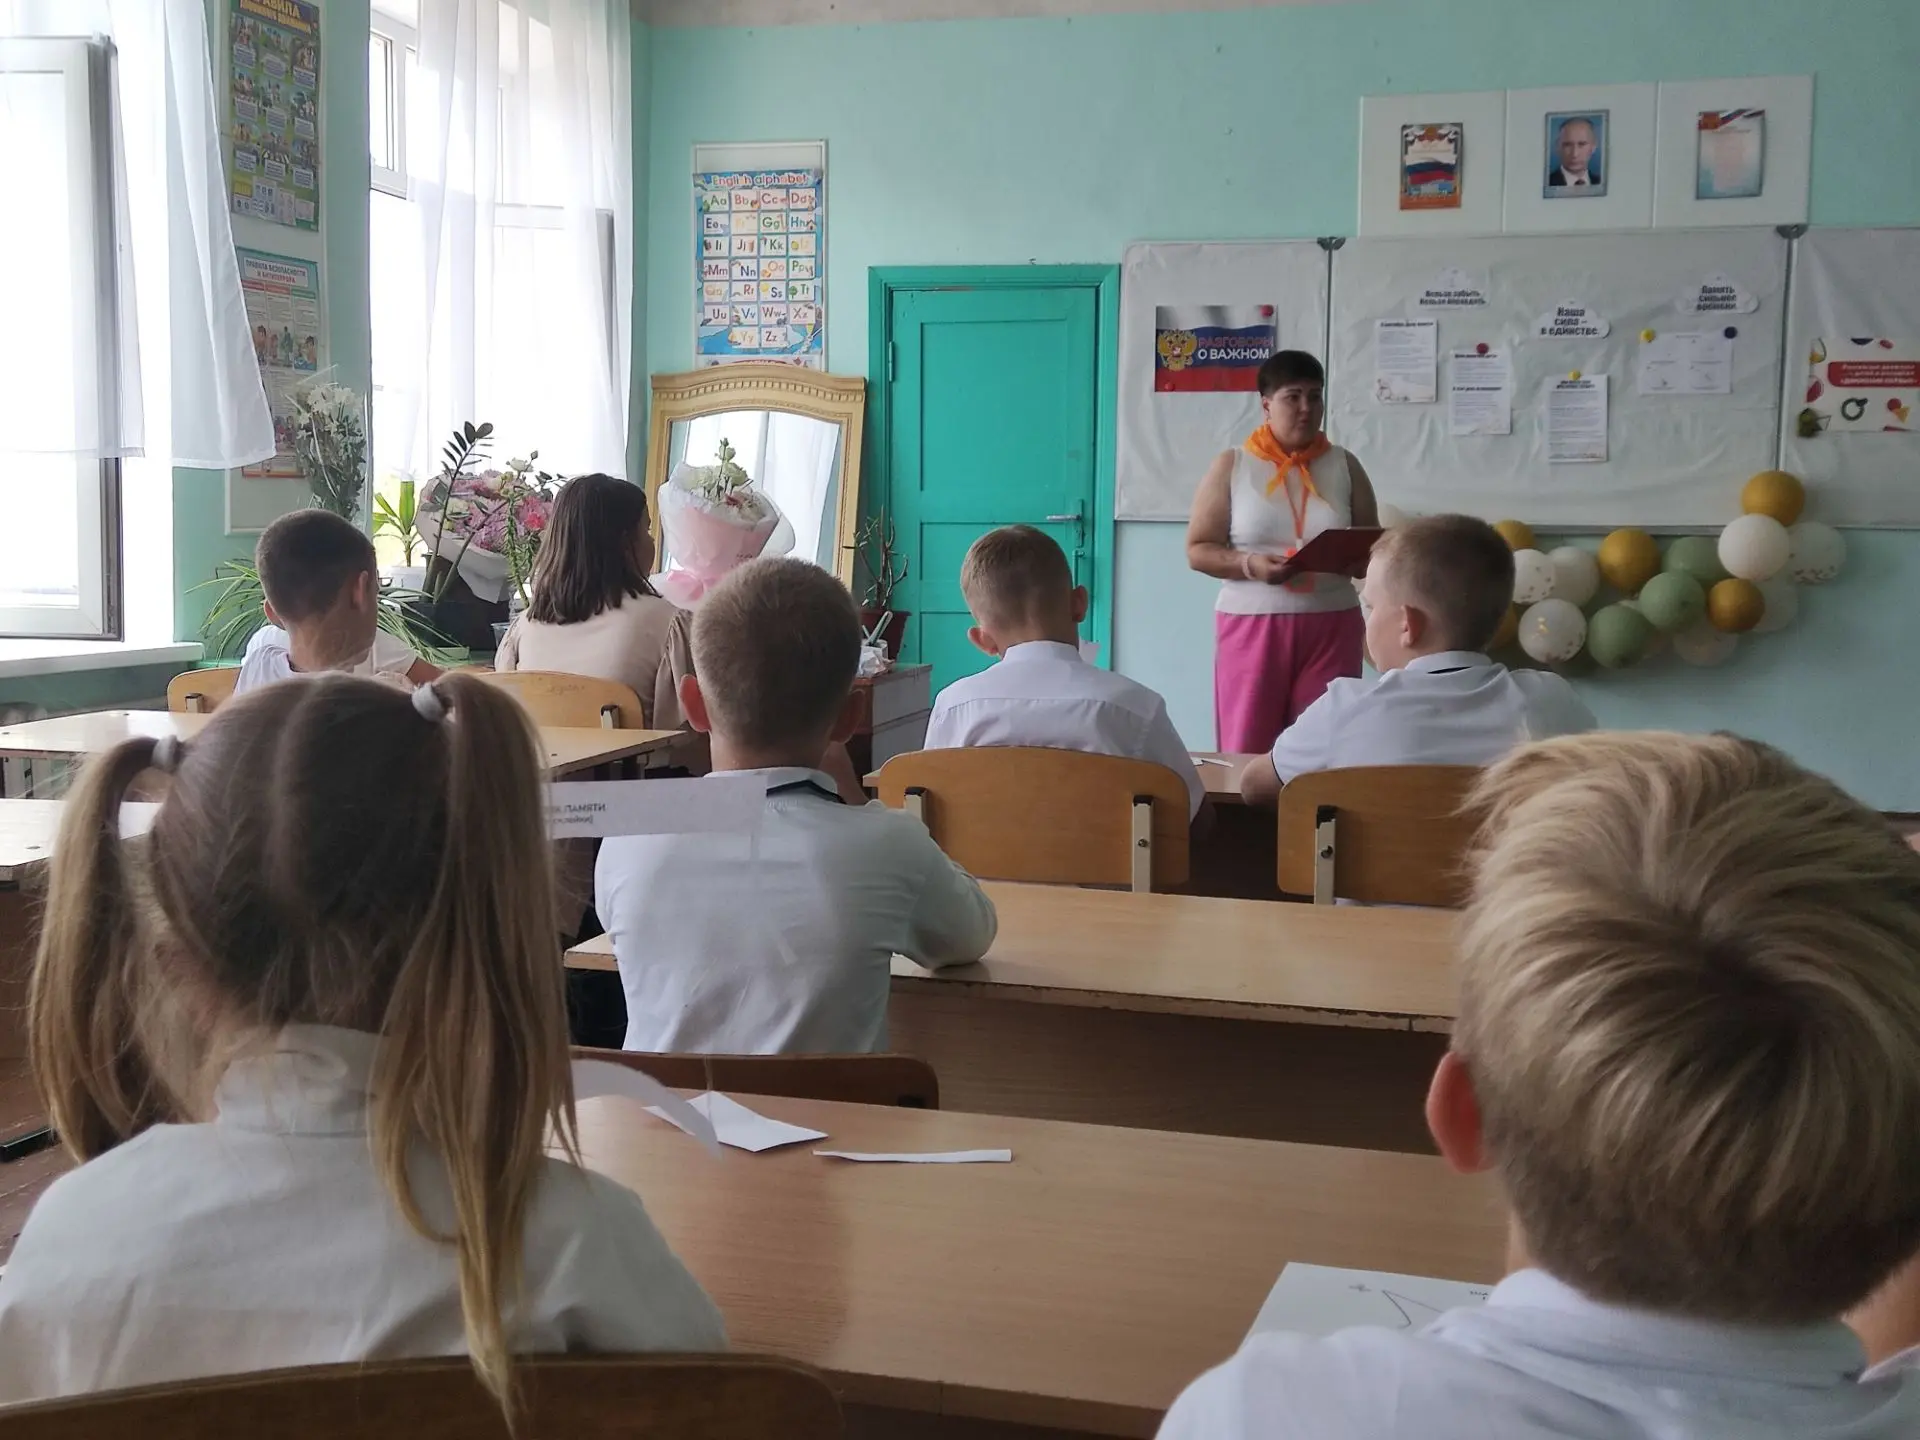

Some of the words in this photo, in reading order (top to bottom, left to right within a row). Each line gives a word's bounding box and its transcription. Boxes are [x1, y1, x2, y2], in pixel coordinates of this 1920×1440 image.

[712, 175, 751, 187] English
[754, 173, 808, 187] alphabet
[711, 195, 727, 206] Aa
[735, 193, 749, 205] Bb
[761, 192, 778, 204] Cc
[740, 266, 756, 277] Nn
[712, 308, 727, 319] Uu
[741, 308, 756, 319] Vv
[1557, 307, 1585, 316] Наша
[1555, 318, 1579, 326] сила
[765, 330, 777, 342] Zz
[1198, 336, 1274, 348] РАЗГОВОРЫ
[1198, 349, 1207, 360] О
[1210, 348, 1270, 360] ВАЖНОМ
[565, 803, 606, 812] ПАМЯТИ
